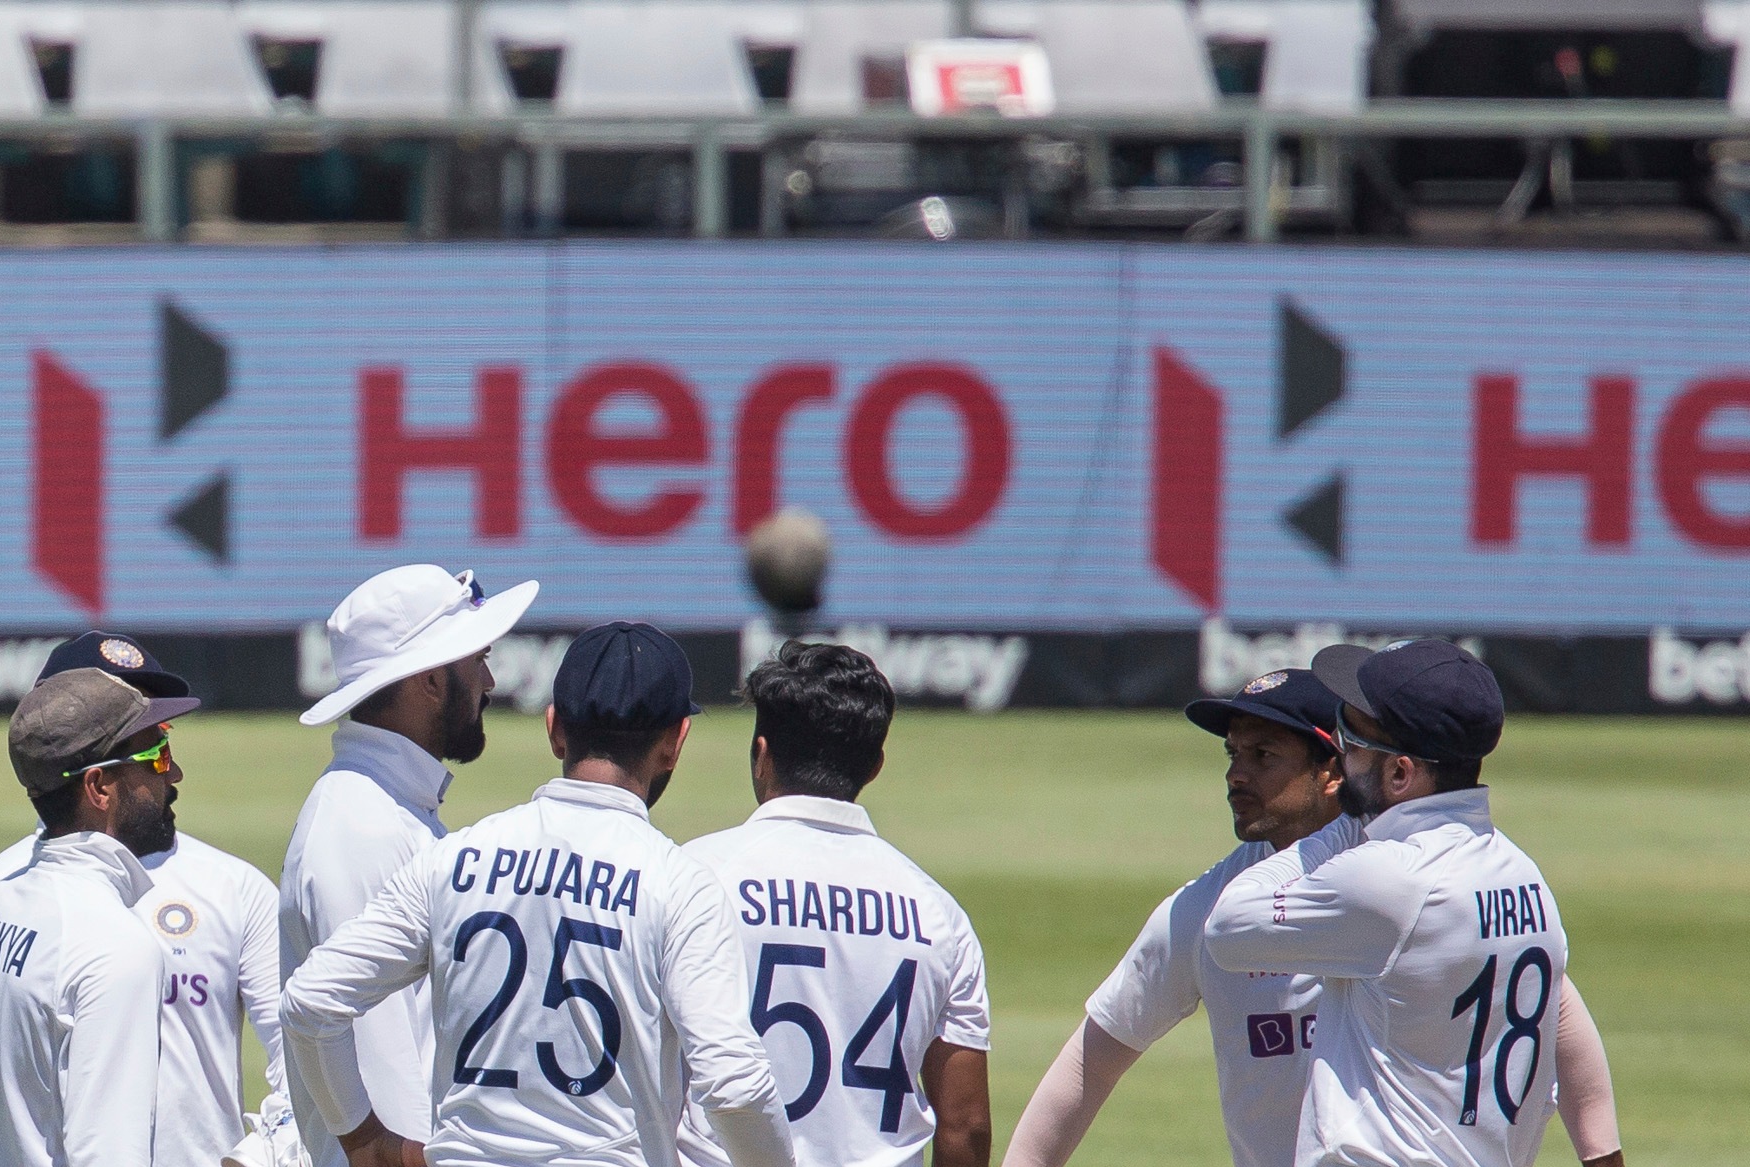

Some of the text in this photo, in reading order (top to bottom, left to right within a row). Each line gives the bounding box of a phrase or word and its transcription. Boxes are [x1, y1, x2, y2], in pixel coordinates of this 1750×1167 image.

[357, 359, 1014, 546] Hero
[452, 847, 641, 917] C PUJARA
[738, 878, 933, 946] SHARDUL
[1475, 883, 1548, 939] VIRAT
[453, 911, 623, 1097] 25
[750, 943, 918, 1133] 54
[1450, 946, 1552, 1127] 18
